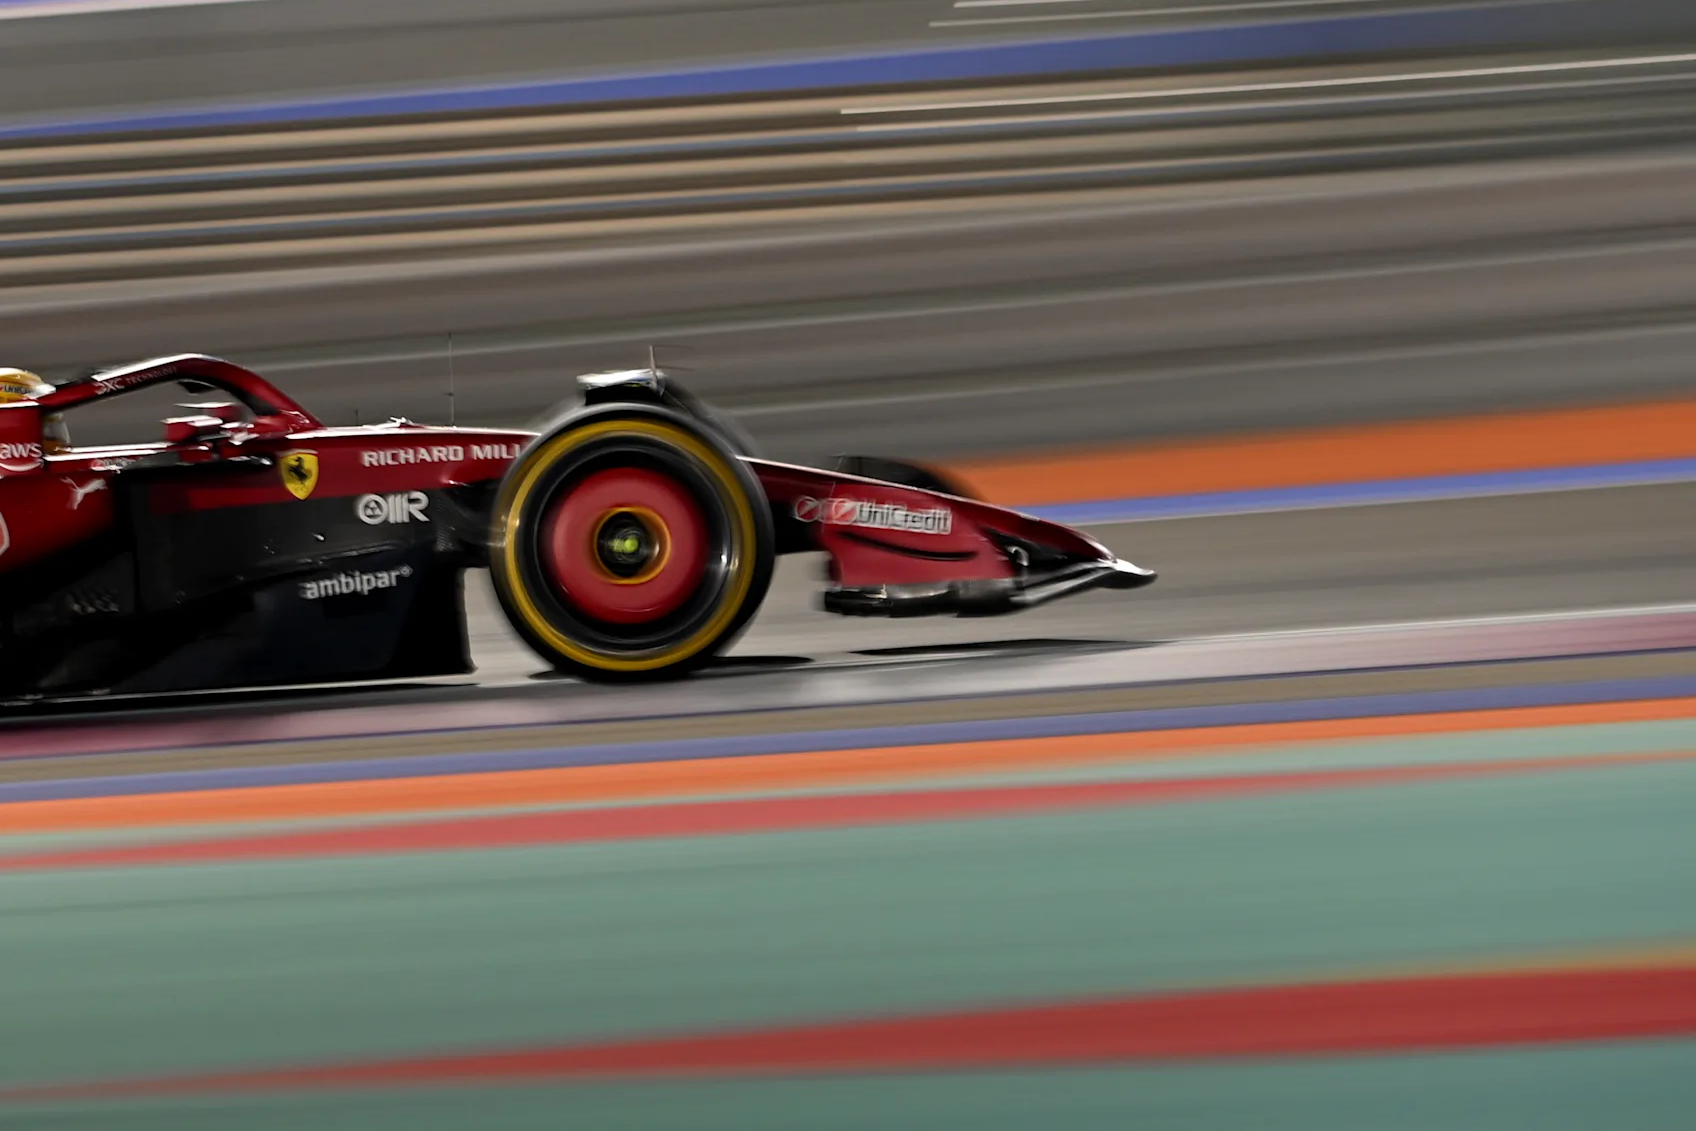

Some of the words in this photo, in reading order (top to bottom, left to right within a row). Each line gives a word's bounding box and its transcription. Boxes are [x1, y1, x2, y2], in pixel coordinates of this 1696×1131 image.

[362, 445, 464, 467] RICHARD
[469, 443, 521, 460] MILL
[856, 500, 952, 535] UniCredit
